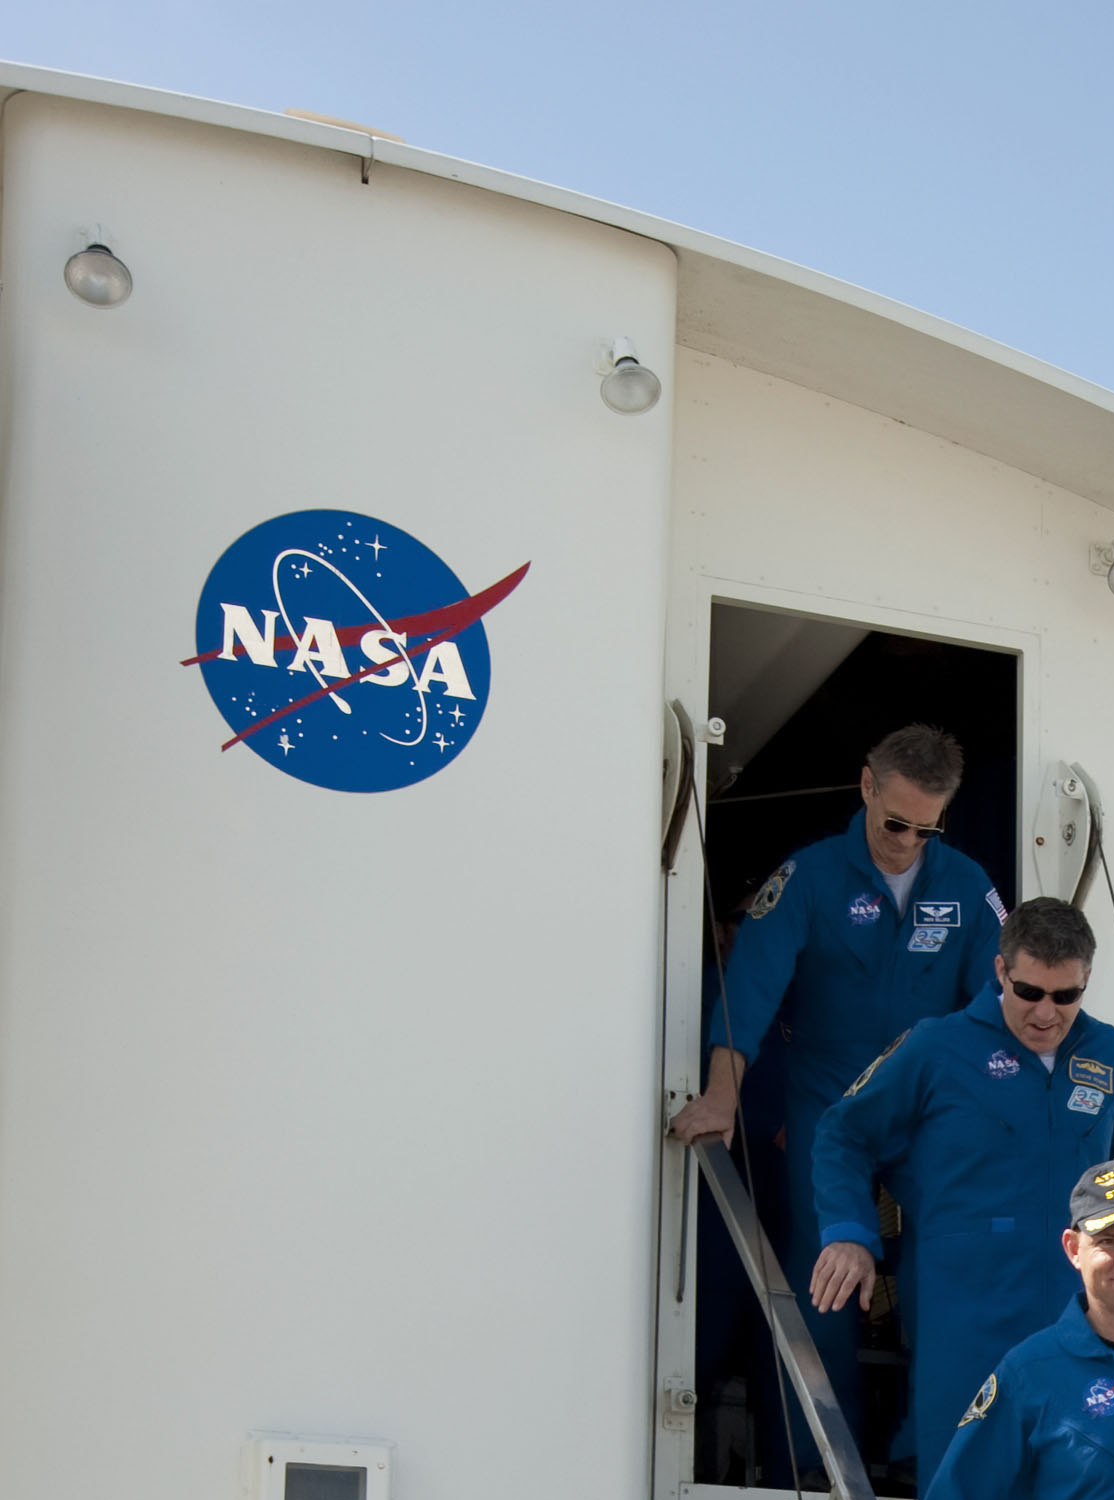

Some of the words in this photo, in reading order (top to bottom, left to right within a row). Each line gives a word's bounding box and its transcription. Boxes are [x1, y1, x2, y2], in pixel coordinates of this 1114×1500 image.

[218, 602, 477, 701] NASA
[850, 905, 880, 915] NASA
[911, 930, 942, 949] 25
[988, 1060, 1020, 1070] NASA
[1072, 1090, 1099, 1110] 25
